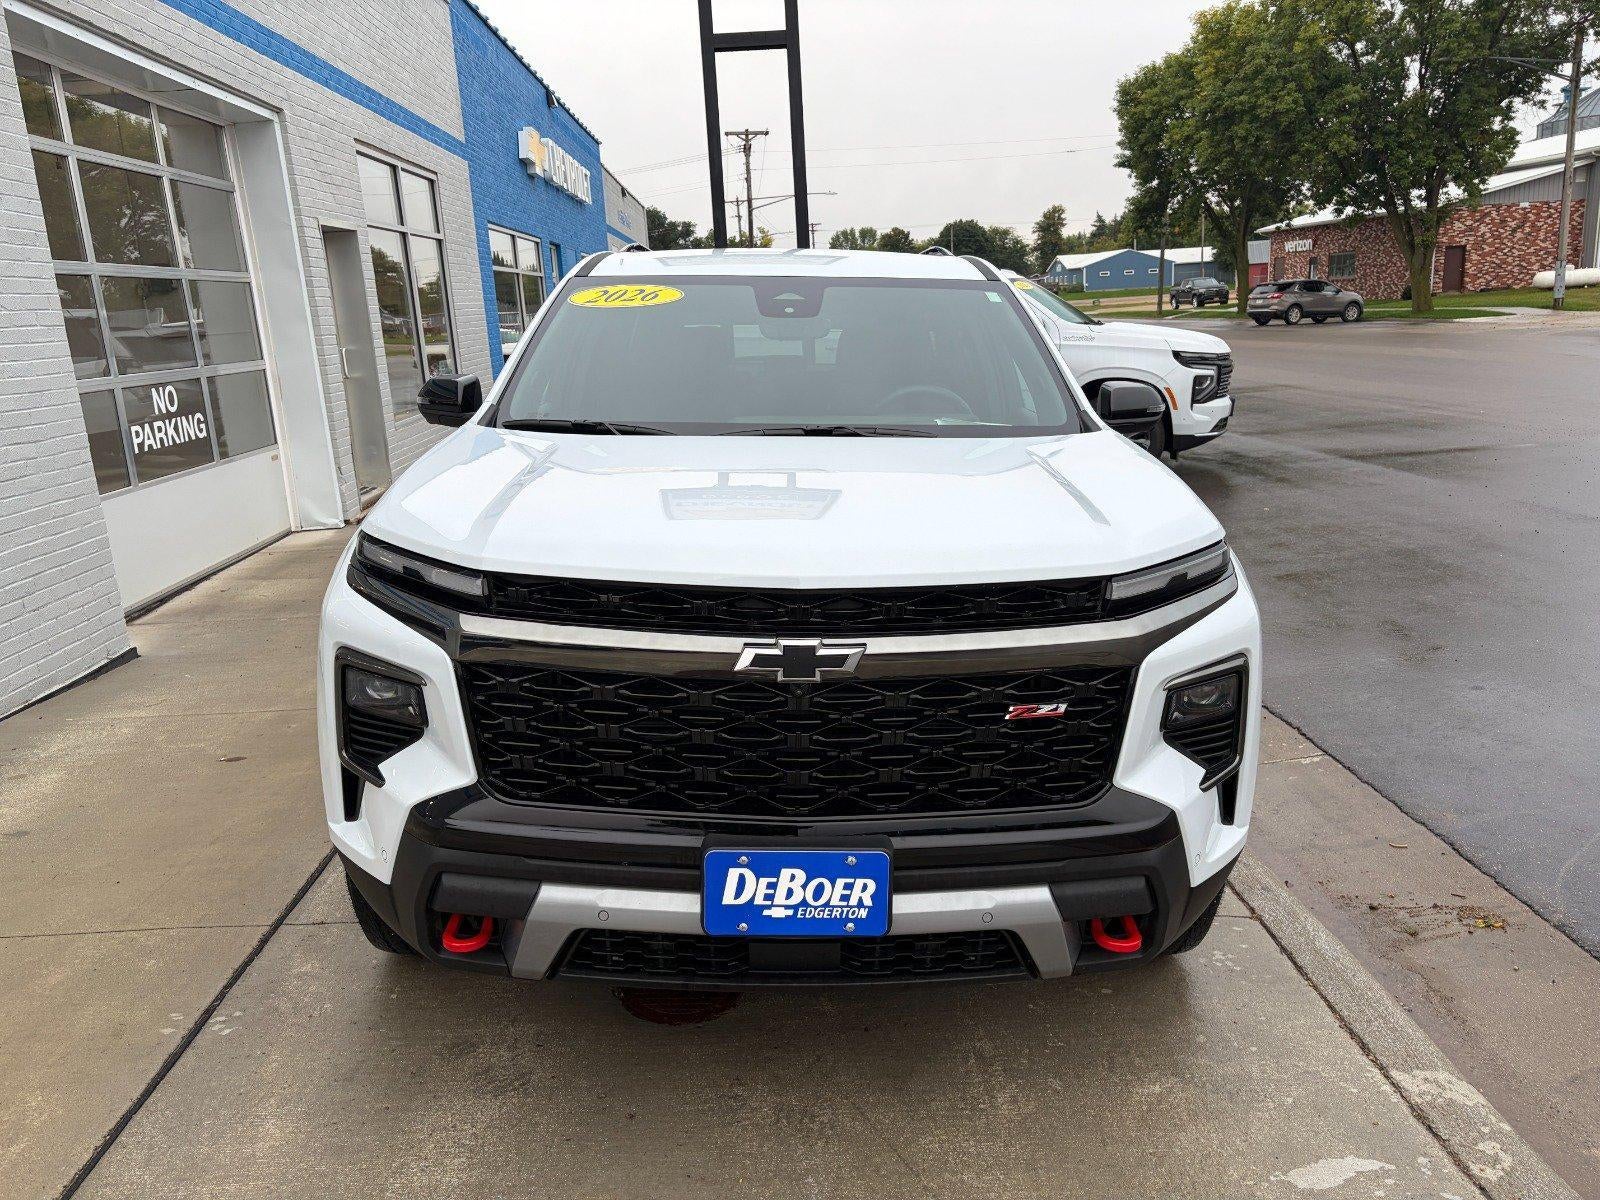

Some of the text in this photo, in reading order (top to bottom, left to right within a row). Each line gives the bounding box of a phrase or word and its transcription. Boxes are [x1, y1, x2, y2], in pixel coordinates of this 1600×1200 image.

[1284, 236, 1313, 252] verizon
[584, 288, 662, 304] 2026
[151, 385, 178, 415] NO
[130, 412, 207, 454] PARKING
[796, 907, 869, 919] EDGERTON
